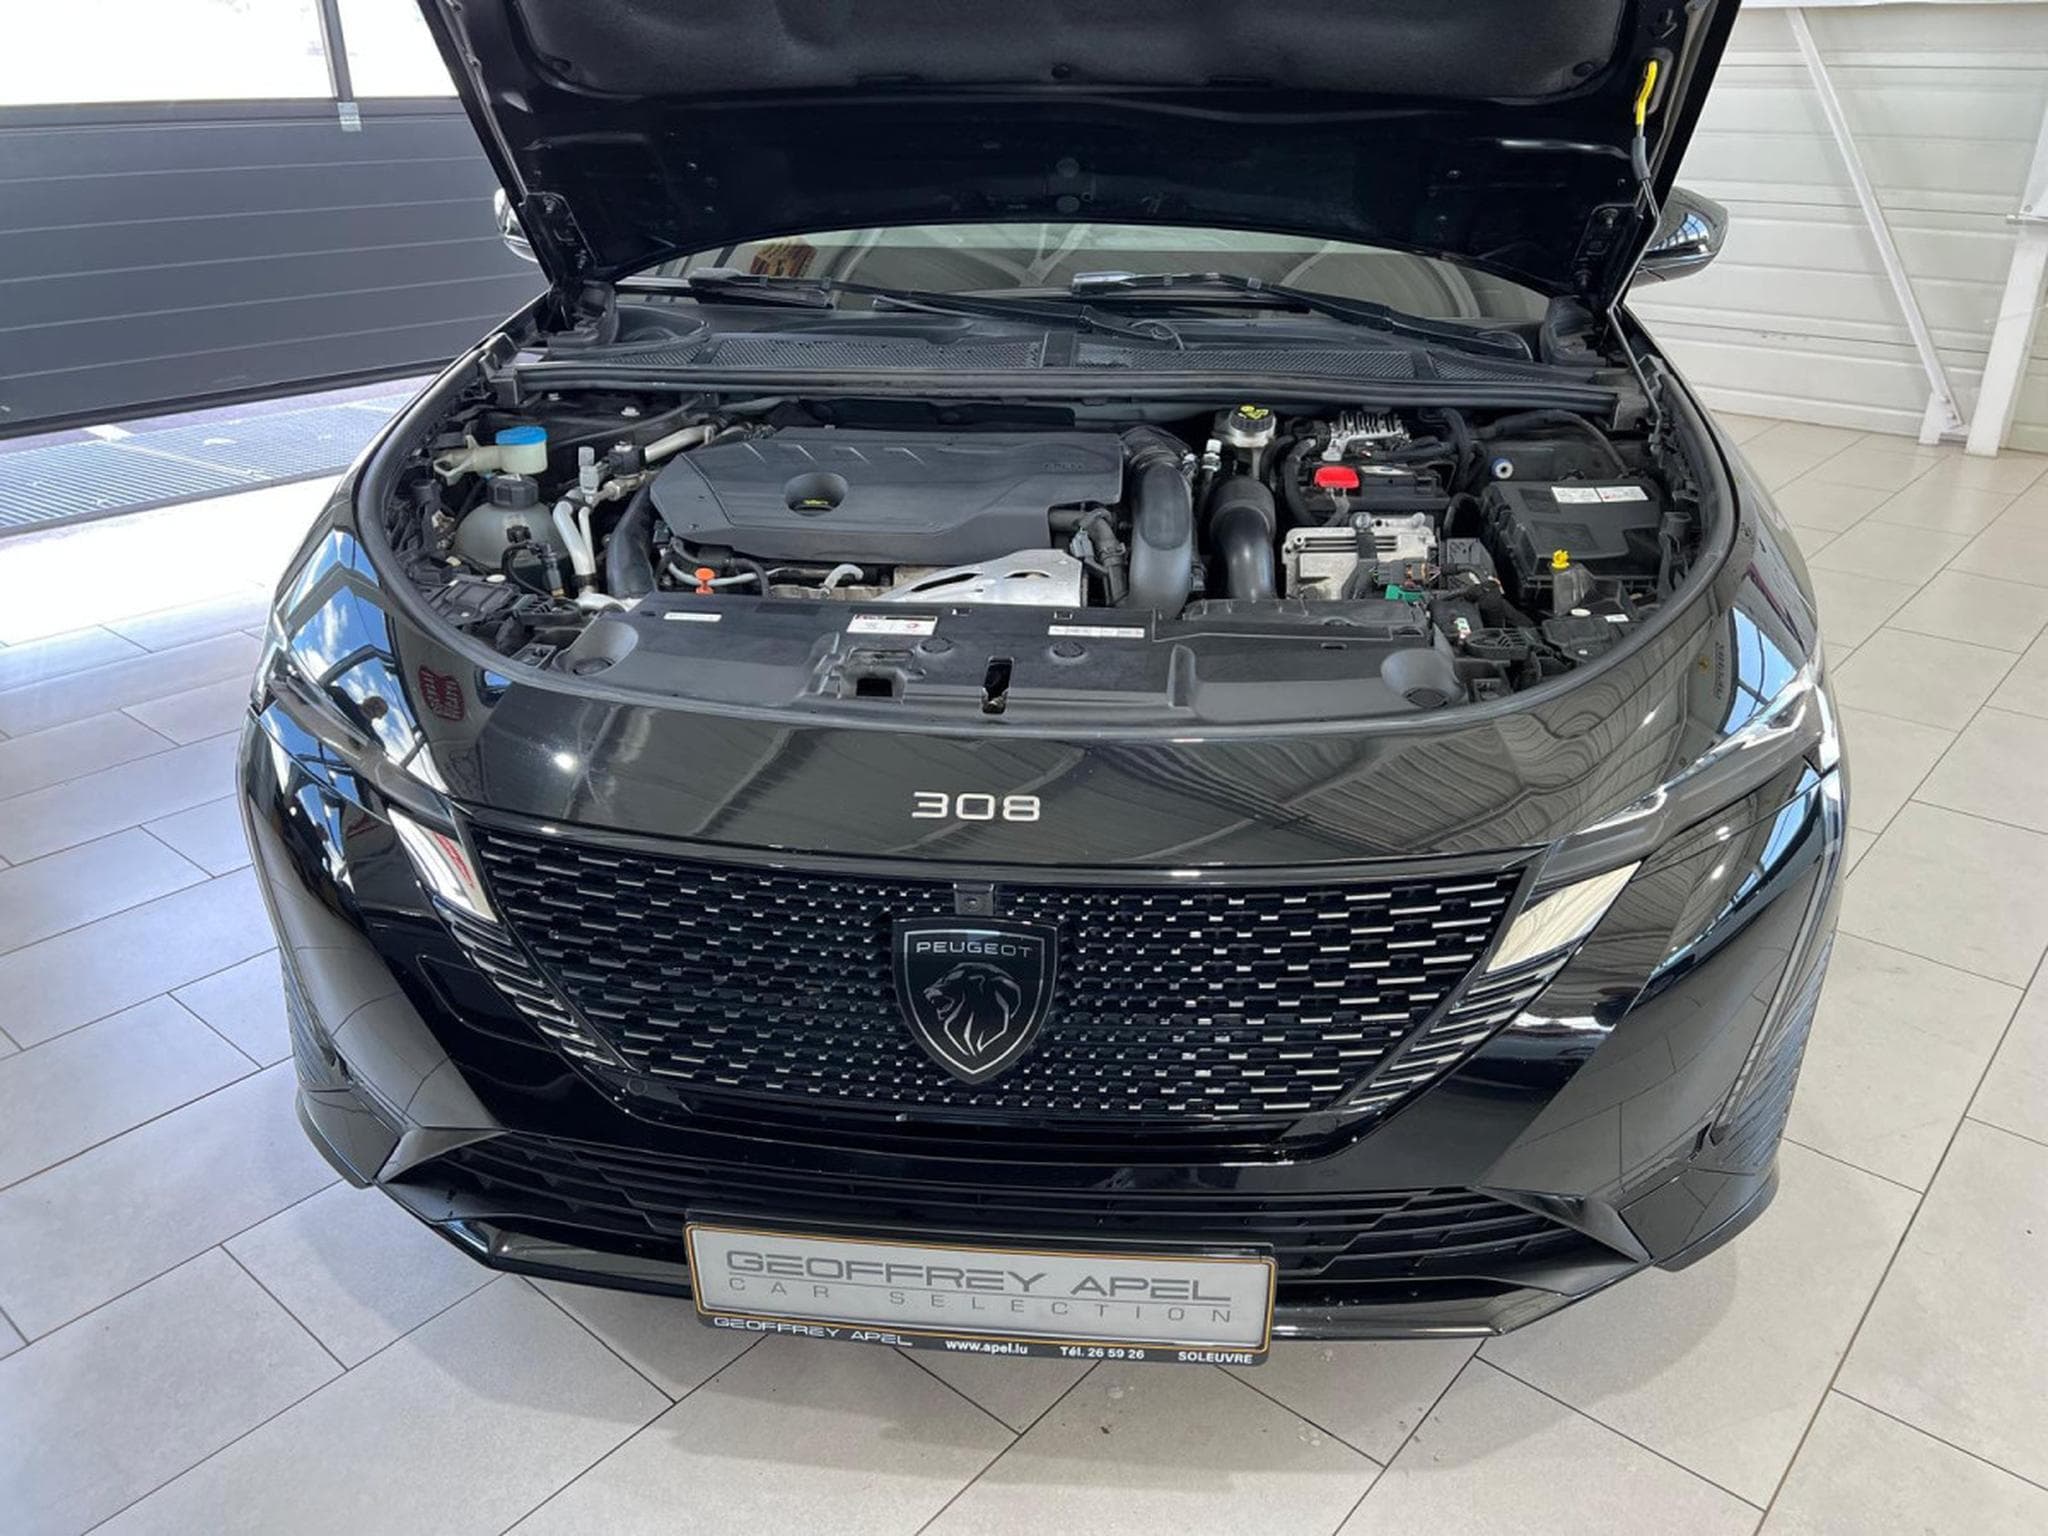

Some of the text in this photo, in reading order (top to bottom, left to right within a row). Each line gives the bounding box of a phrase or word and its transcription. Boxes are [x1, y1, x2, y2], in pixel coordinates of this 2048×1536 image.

[912, 791, 1041, 821] 308
[916, 941, 1032, 958] PEUGEOT
[727, 1250, 1231, 1301] GEOFFREY APEL
[729, 1277, 1231, 1323] CAR SELECTION
[714, 1317, 913, 1346] GEOFFREY APEL
[945, 1339, 1028, 1355] www.apel.lu
[1060, 1345, 1145, 1360] Tél. 26 59 26
[1177, 1350, 1253, 1364] SOLEUVRE
